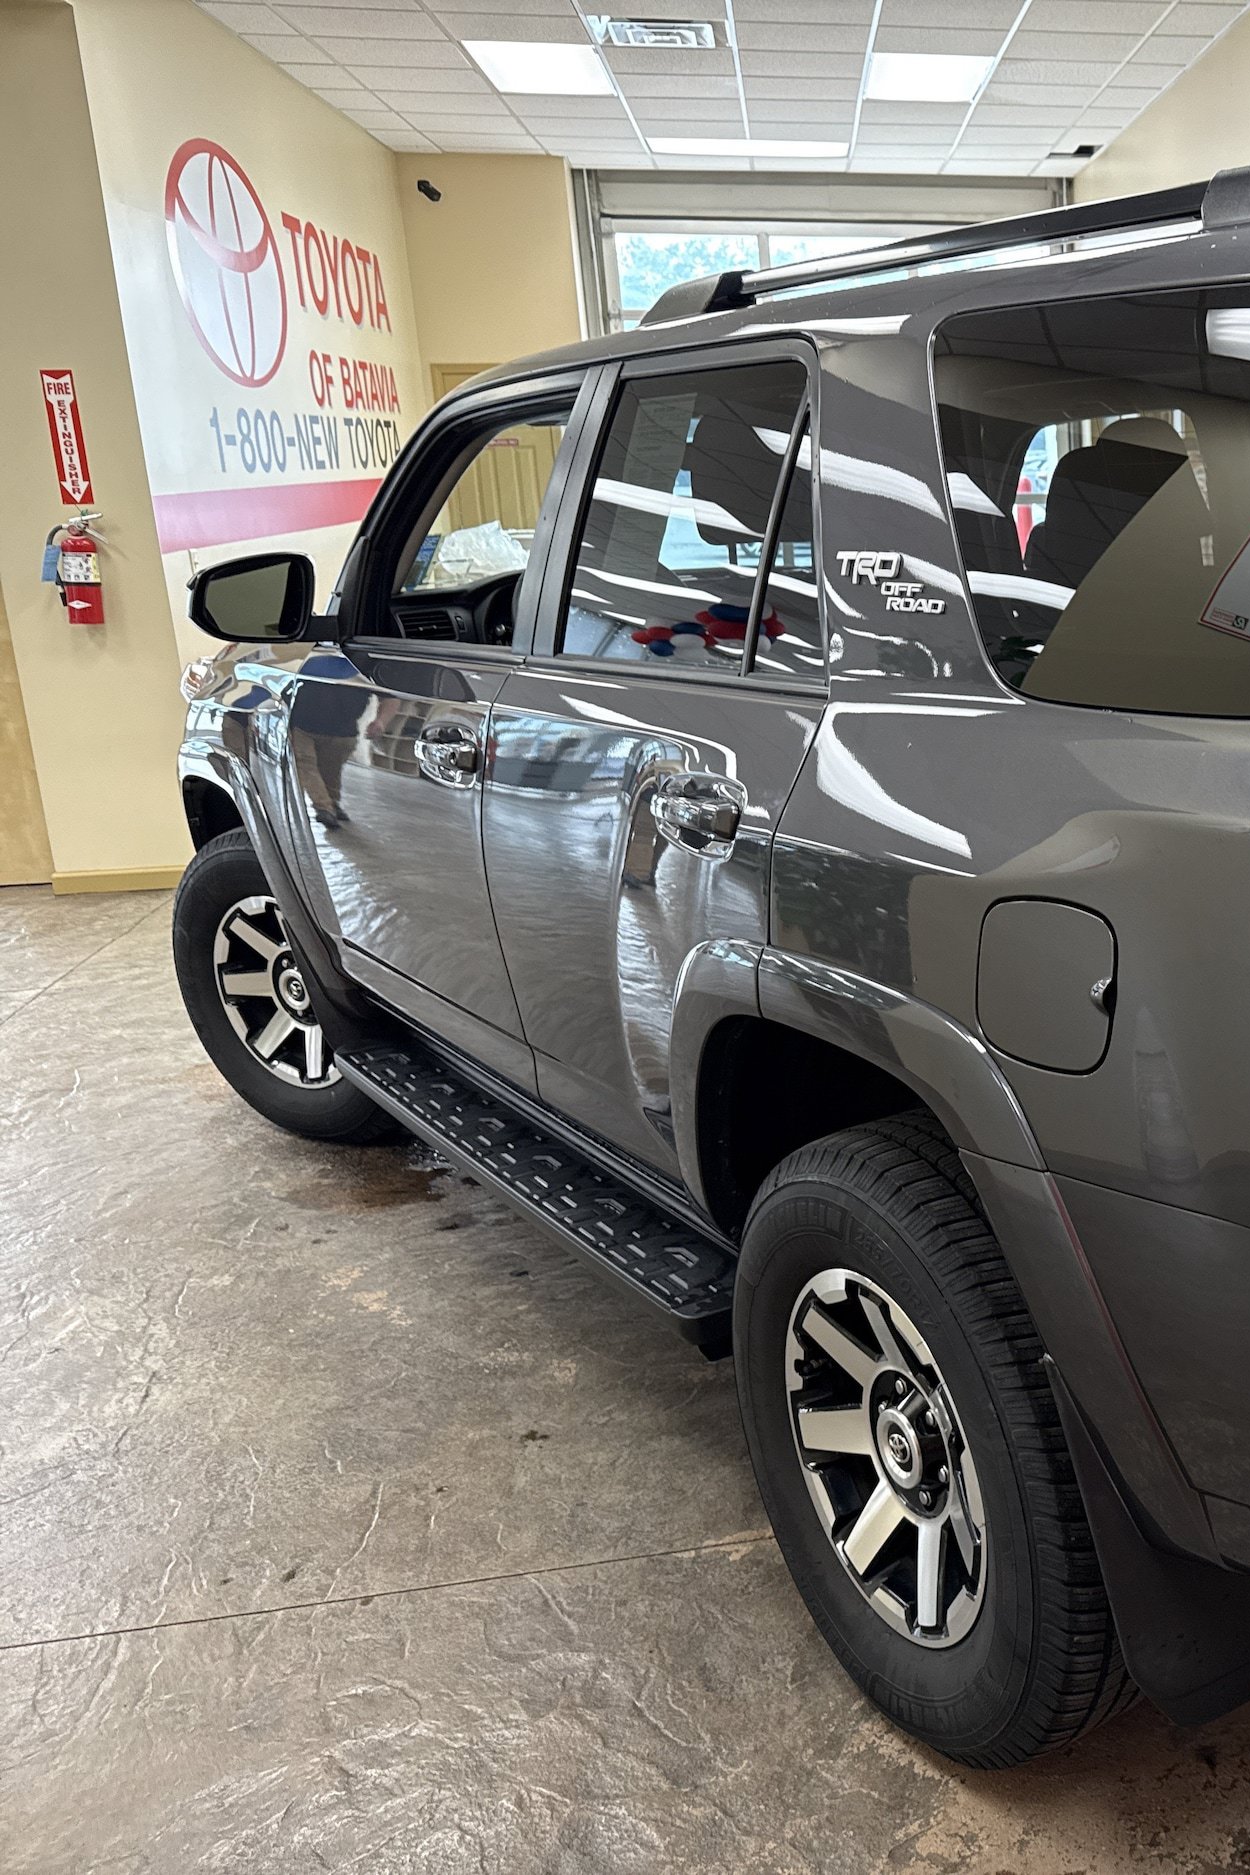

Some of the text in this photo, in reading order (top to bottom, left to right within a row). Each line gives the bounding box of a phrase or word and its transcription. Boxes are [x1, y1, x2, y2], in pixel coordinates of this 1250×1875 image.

[281, 211, 392, 332] TOYOTA
[46, 382, 71, 395] FIRE
[308, 349, 401, 414] OF BATAVIA
[57, 399, 81, 494] EXTINGUISHER
[210, 406, 400, 473] 1-800-NEW TOYOTA
[836, 550, 903, 585] TRD
[880, 581, 925, 597] OFF
[885, 597, 947, 614] ROAD
